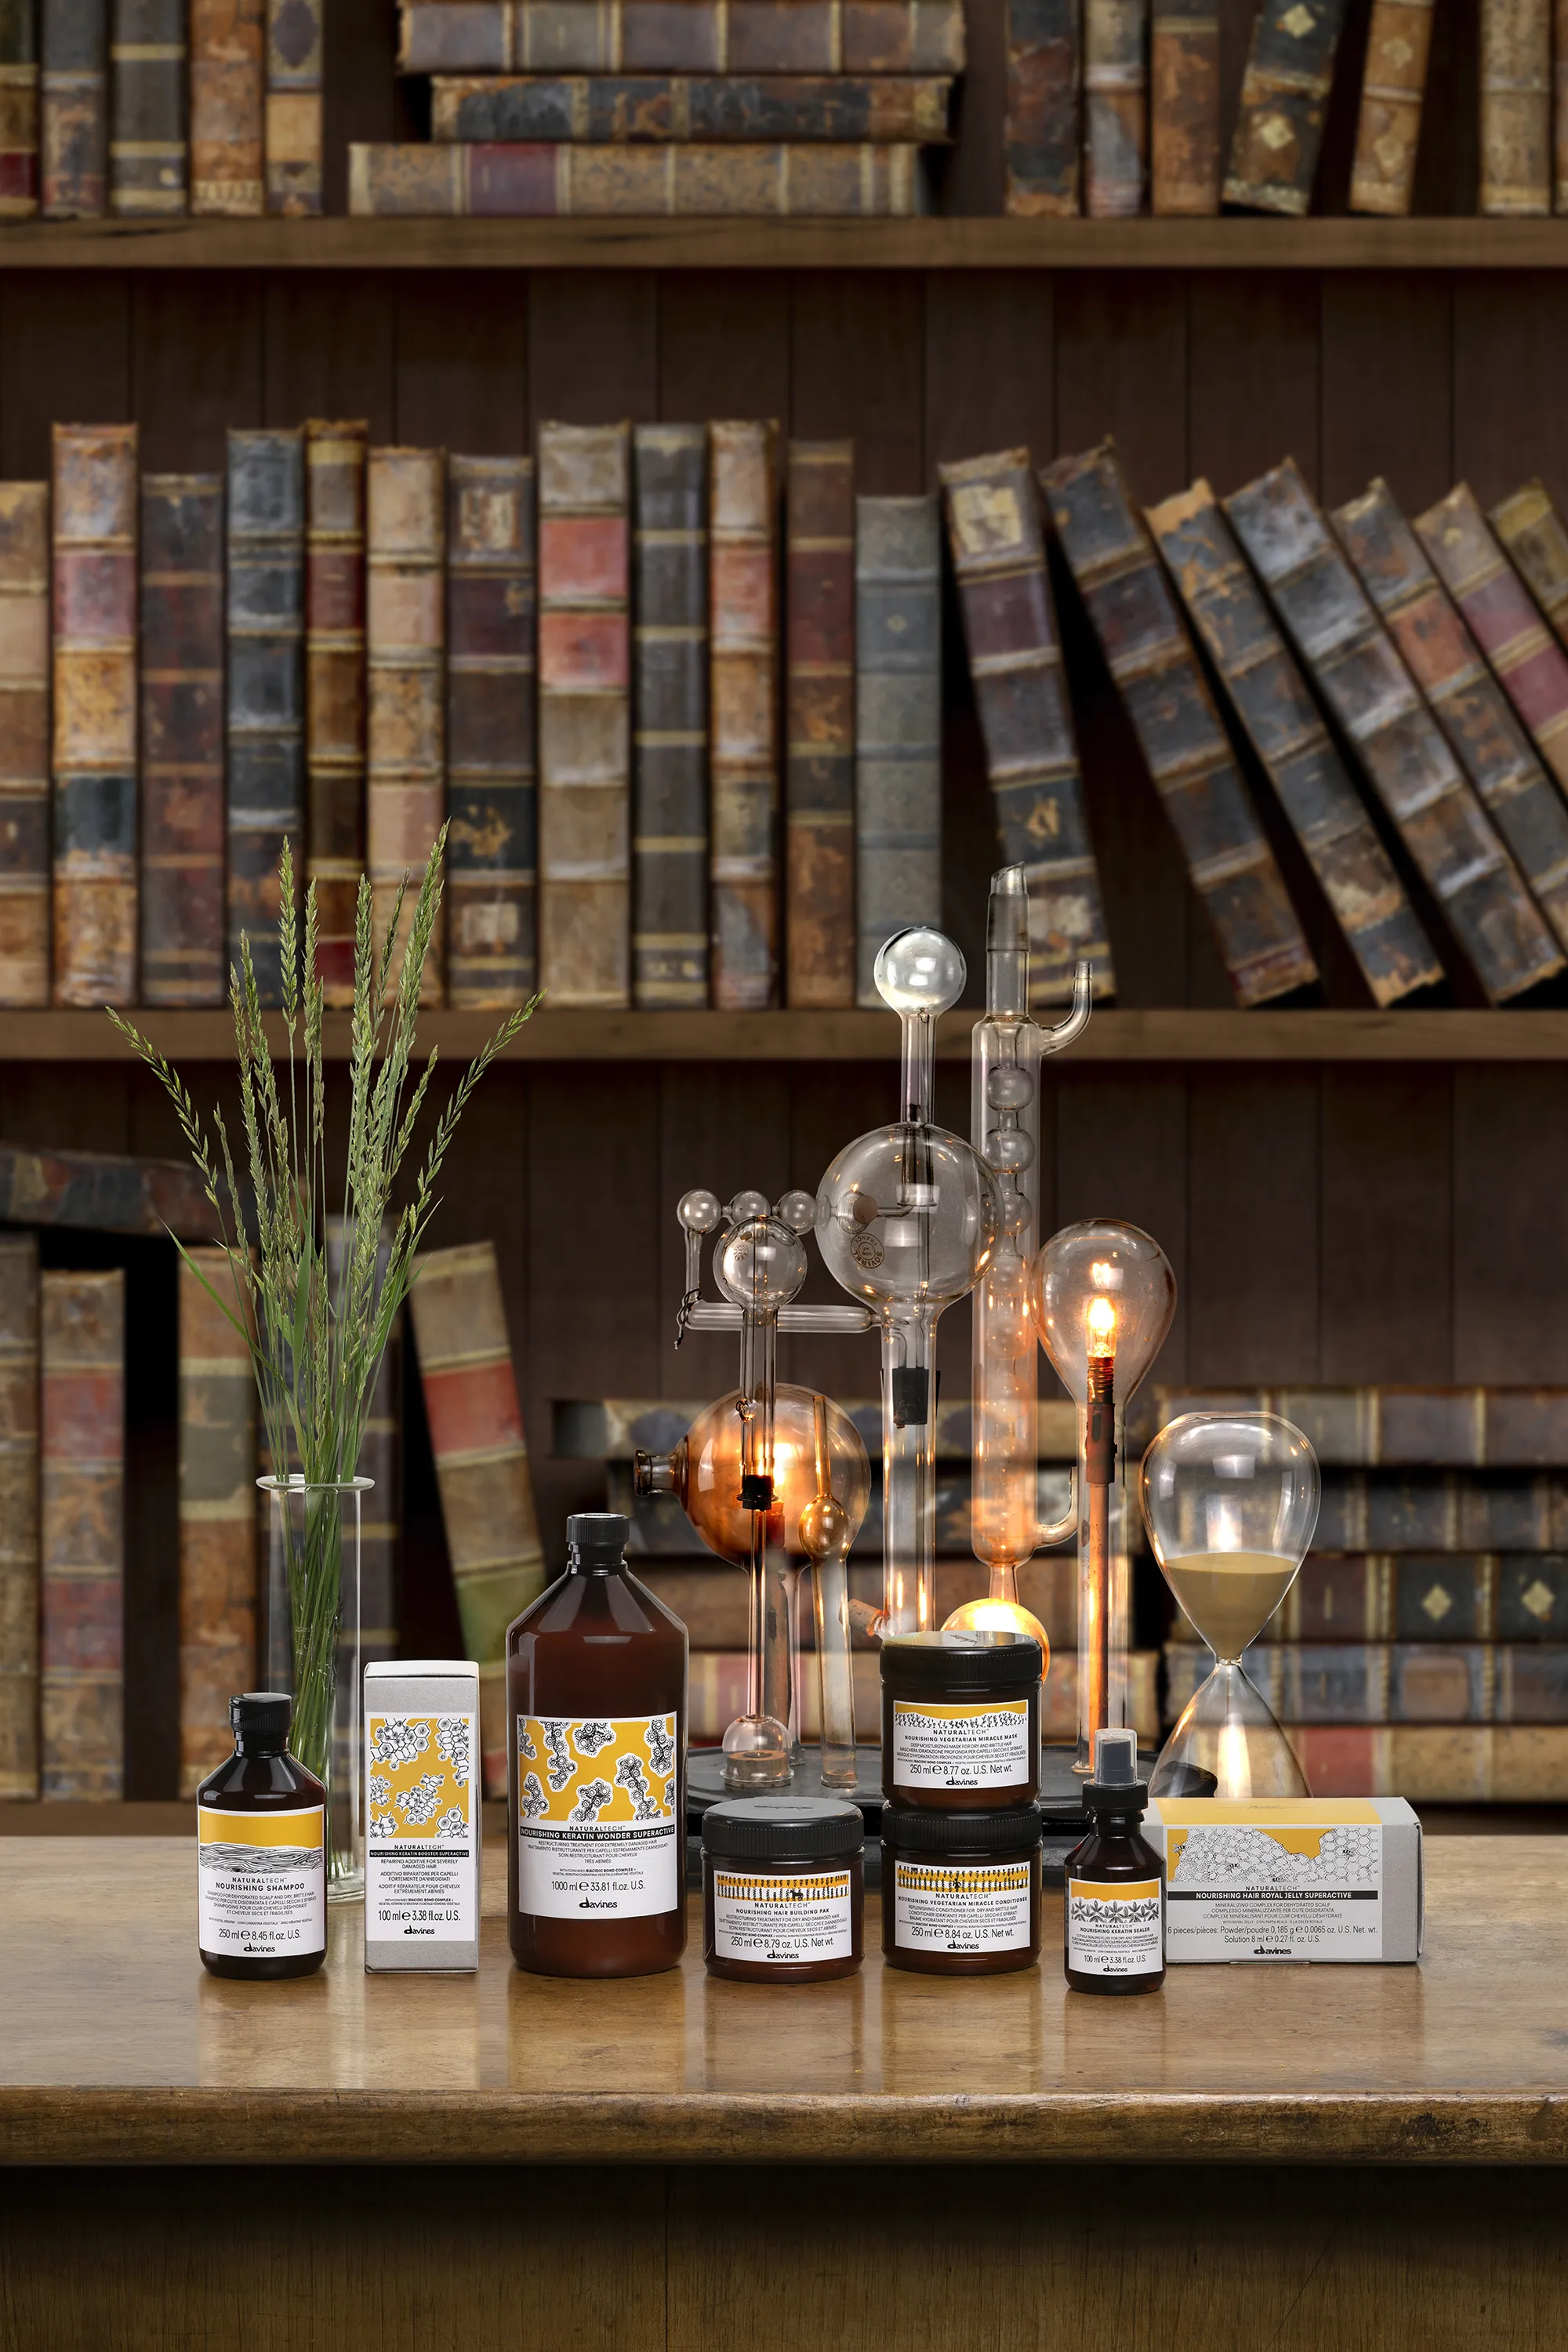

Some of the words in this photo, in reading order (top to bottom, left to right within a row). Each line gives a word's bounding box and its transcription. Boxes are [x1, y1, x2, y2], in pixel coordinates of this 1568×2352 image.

[855, 1236, 878, 1246] FRANCE
[854, 1250, 882, 1266] SOVIREL
[910, 1764, 922, 1774] 250
[923, 1765, 931, 1774] ml
[943, 1766, 959, 1775] 8.77
[973, 1765, 988, 1774] U.S.
[990, 1765, 1003, 1773] Net
[1004, 1764, 1013, 1773] wt.
[946, 1776, 978, 1785] davines
[521, 1828, 560, 1838] NOURISHING
[633, 1826, 674, 1838] SUPERACTIVE
[216, 1882, 263, 1891] NOURISHING
[552, 1881, 568, 1891] 1000
[569, 1881, 578, 1891] ml
[590, 1882, 610, 1891] 33.81
[631, 1880, 645, 1889] U.S.
[579, 1896, 618, 1908] davines
[898, 1896, 928, 1904] NOURISHING
[379, 1911, 390, 1921] 100
[392, 1911, 401, 1921] ml
[412, 1911, 426, 1921] 3.38
[446, 1911, 461, 1921] U.S.
[220, 1928, 230, 1938] 250
[231, 1930, 239, 1939] ml
[252, 1931, 267, 1940] 8.45
[288, 1929, 301, 1939] U.S.
[404, 1925, 435, 1934] davines
[912, 1926, 923, 1936] 250
[924, 1928, 932, 1937] ml
[945, 1929, 960, 1939] 8.84
[975, 1929, 989, 1939] U.S.
[992, 1929, 1004, 1937] Net
[1005, 1928, 1014, 1936] wt.
[1221, 1926, 1269, 1935] Powder/poudre
[243, 1942, 275, 1952] davines
[731, 1936, 742, 1947] 250
[744, 1938, 752, 1947] ml
[764, 1939, 780, 1948] 8.79
[794, 1938, 809, 1948] U.S.
[811, 1937, 823, 1947] Net
[825, 1936, 834, 1945] wt.
[947, 1940, 979, 1949] davines
[767, 1950, 799, 1959] davines
[1254, 1944, 1292, 1955] davines
